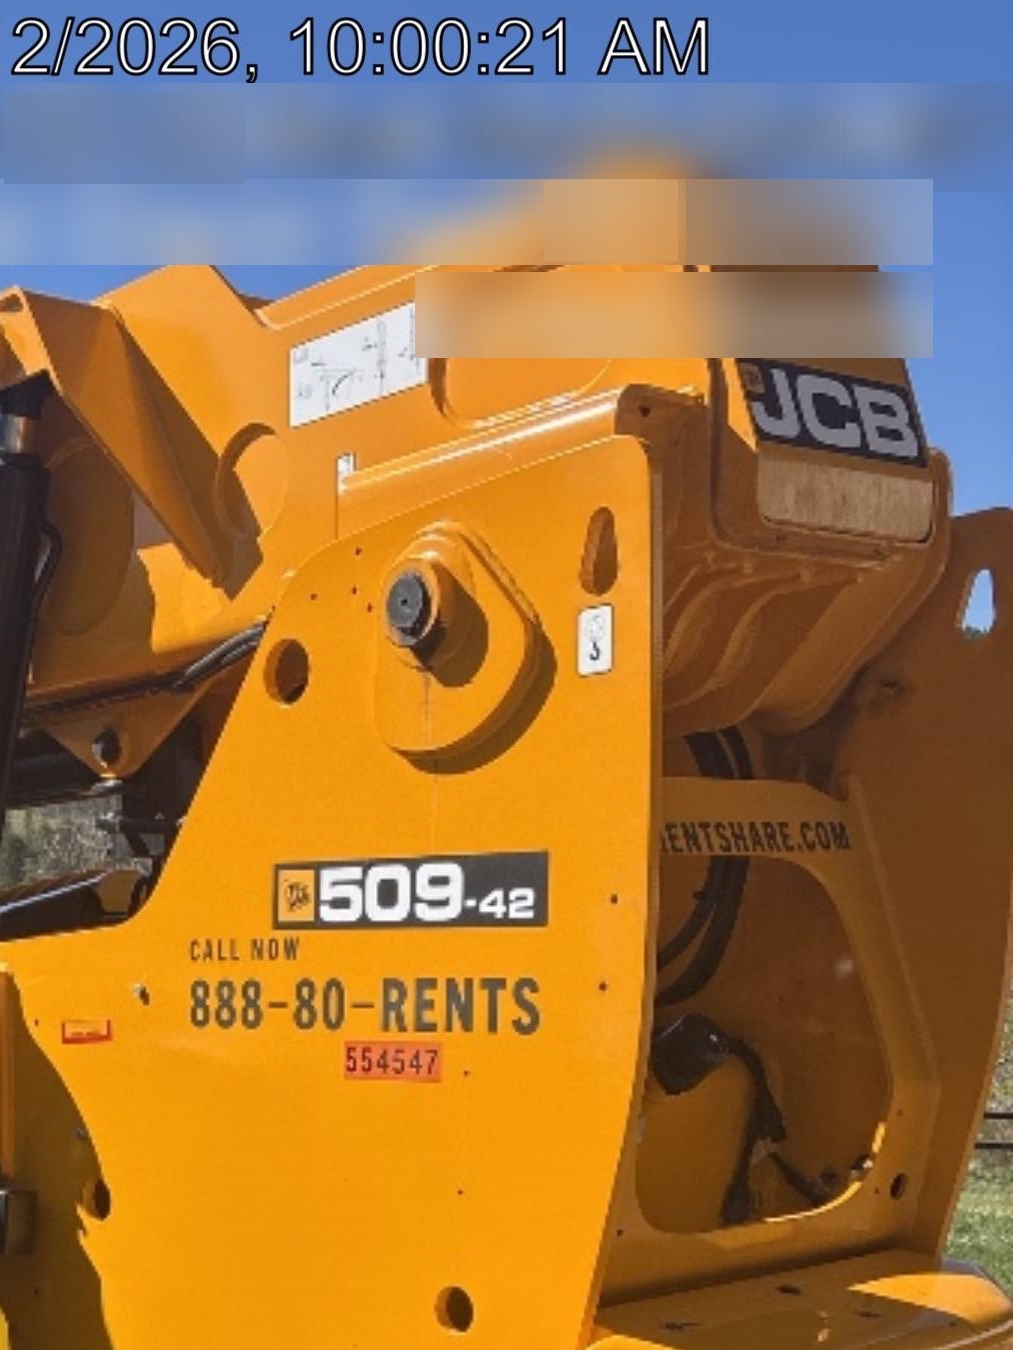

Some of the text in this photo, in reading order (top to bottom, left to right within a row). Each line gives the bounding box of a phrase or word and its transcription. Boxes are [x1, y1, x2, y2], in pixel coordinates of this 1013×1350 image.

[751, 368, 919, 457] JCB
[319, 862, 535, 922] 509-42
[189, 937, 301, 962] CALL NOW
[190, 977, 541, 1036] 888-80-RENTS
[345, 1046, 439, 1076] 554547
